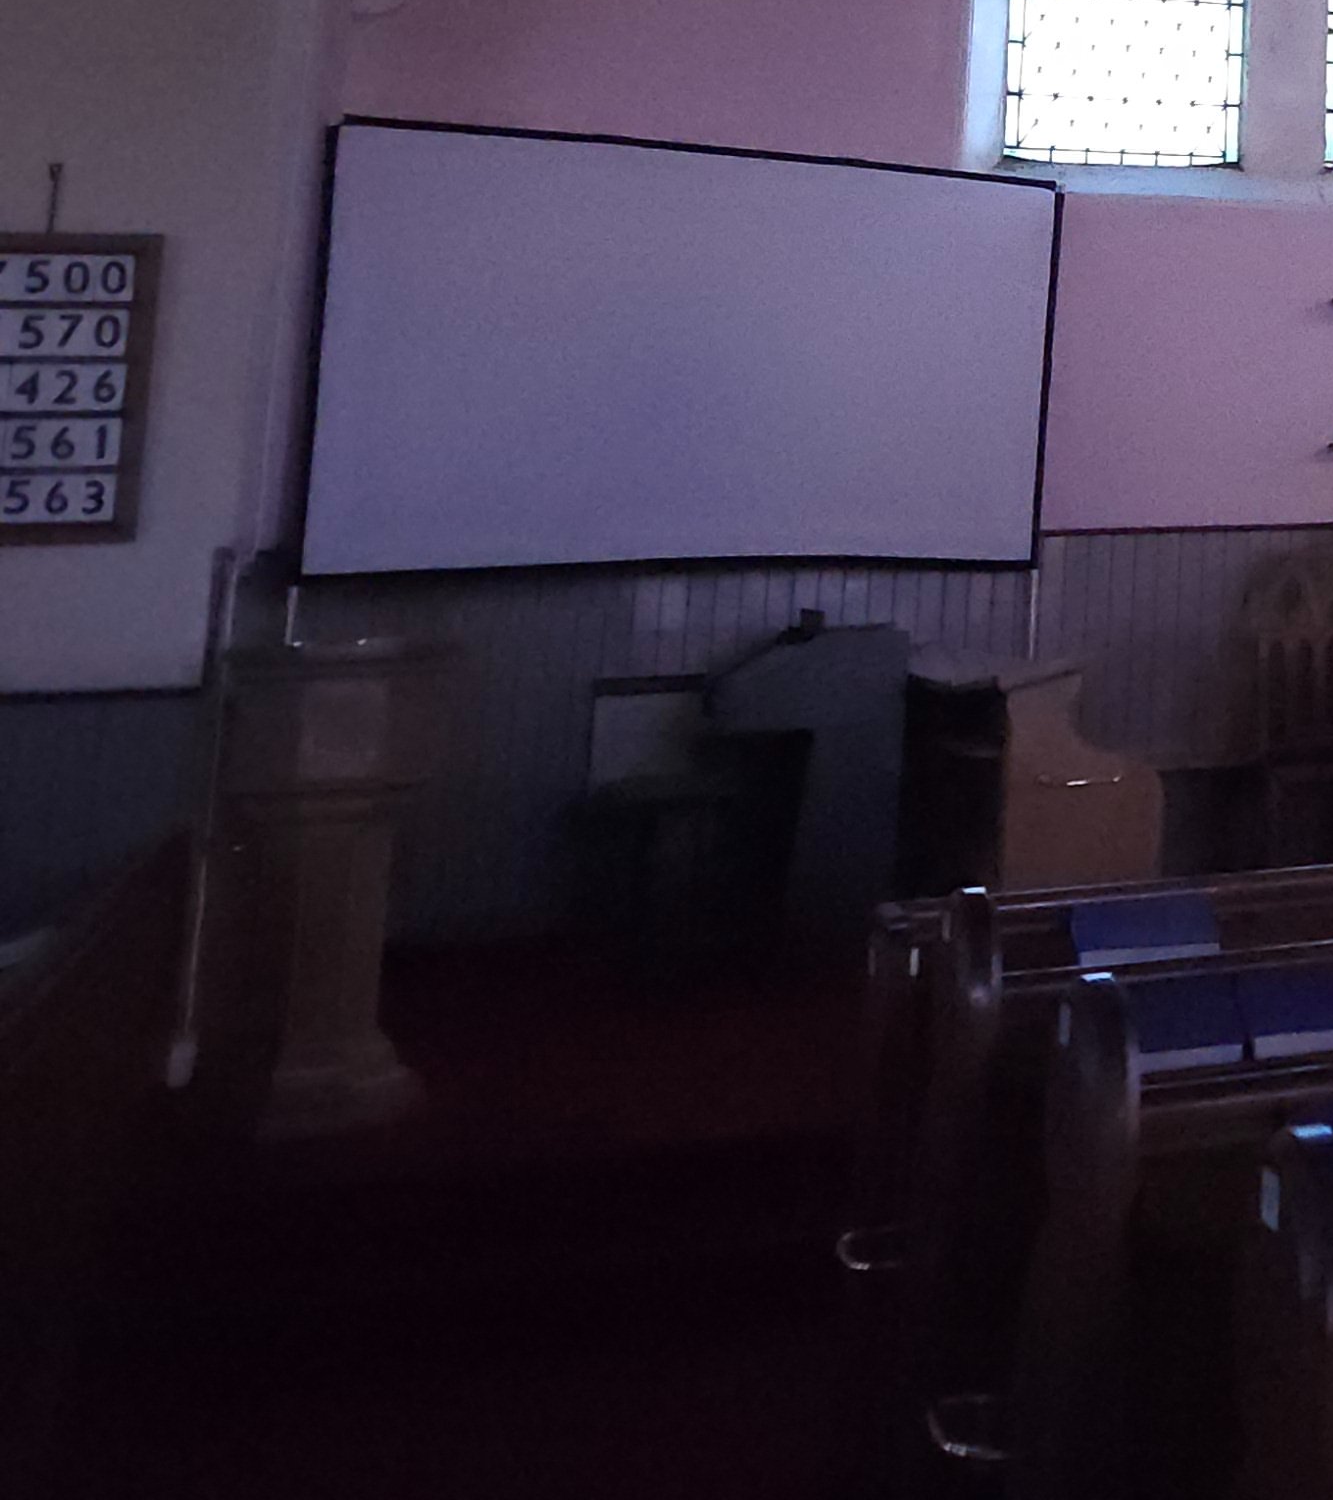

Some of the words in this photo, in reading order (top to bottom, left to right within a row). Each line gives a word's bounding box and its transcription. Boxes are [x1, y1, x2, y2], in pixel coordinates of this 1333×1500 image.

[18, 314, 121, 350] 570
[15, 370, 117, 405] 426
[10, 425, 108, 461] 561
[3, 479, 106, 516] 563
